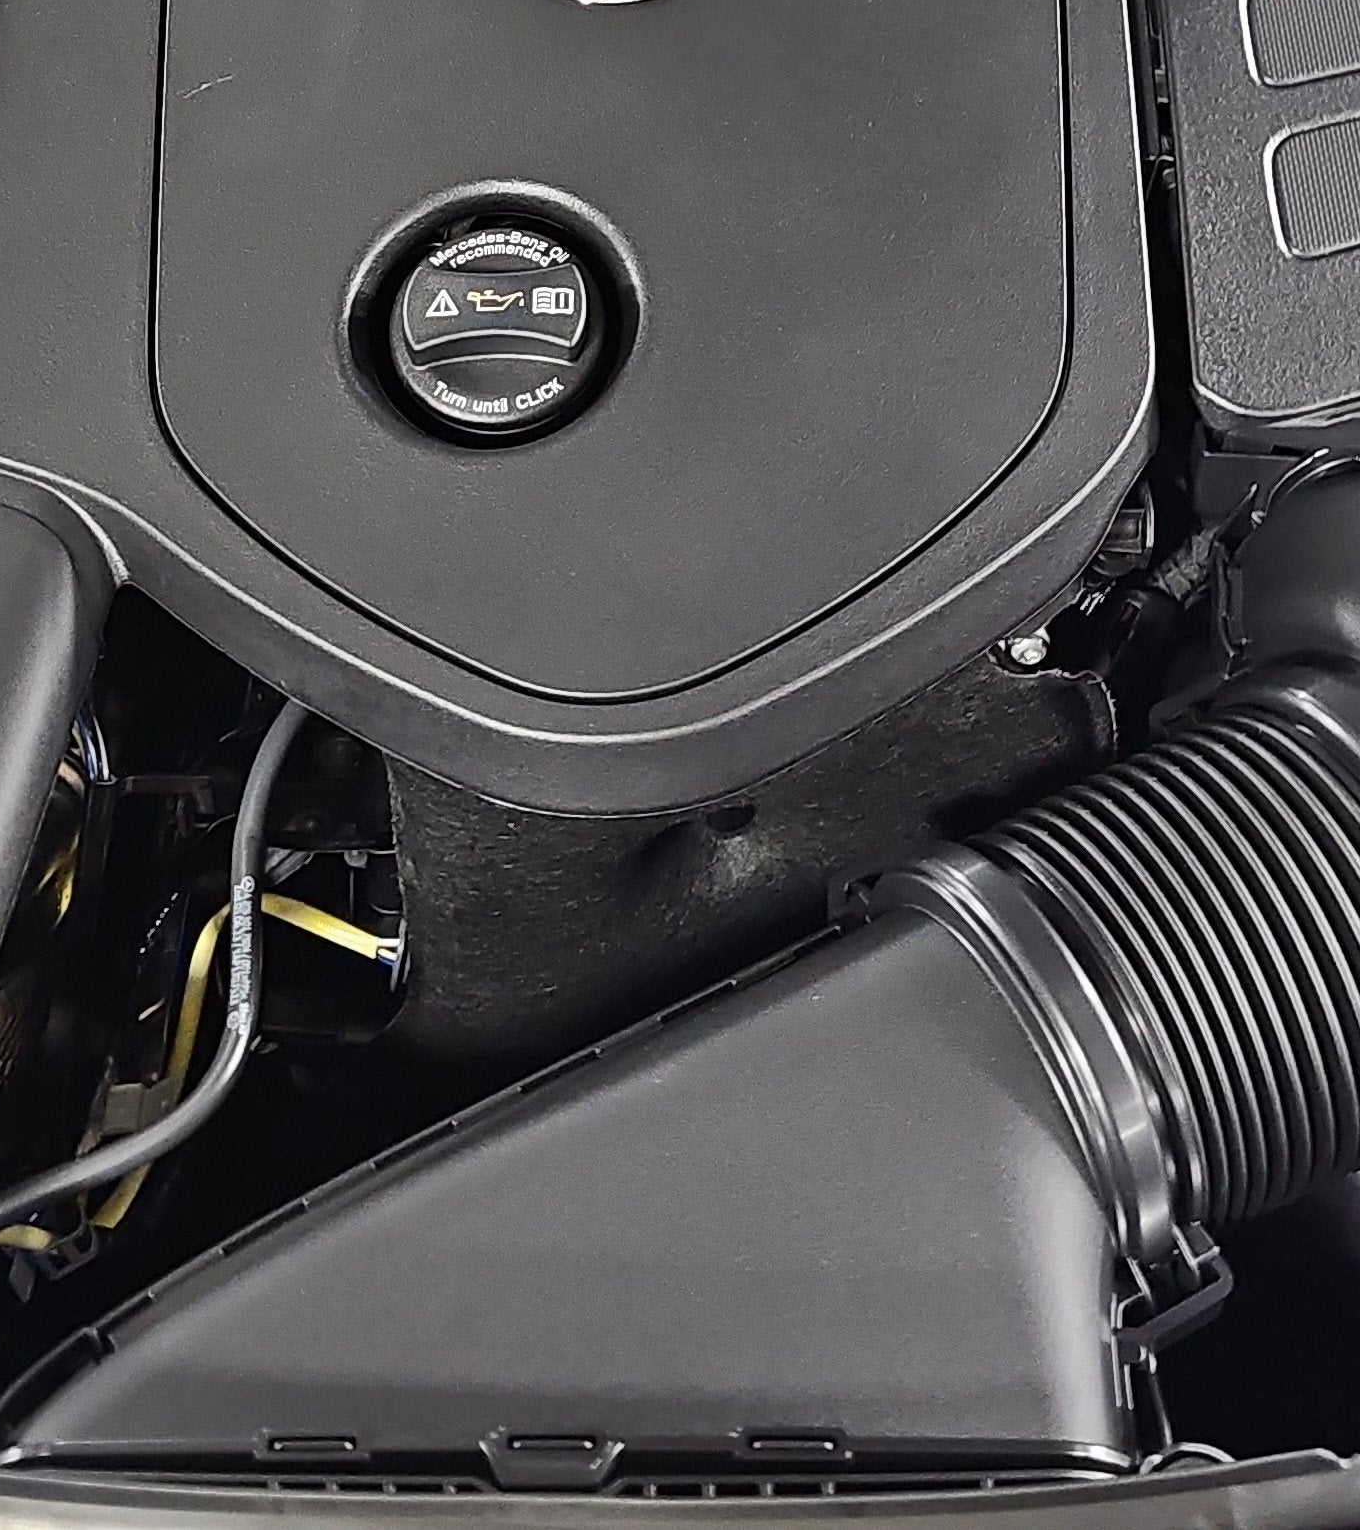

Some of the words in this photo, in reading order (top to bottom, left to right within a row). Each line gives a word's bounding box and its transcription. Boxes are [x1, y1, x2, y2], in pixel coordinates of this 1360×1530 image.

[429, 231, 549, 267] Mercedes-Benz
[549, 244, 571, 264] Oil
[450, 243, 551, 268] recommended
[432, 380, 467, 409] Turn
[472, 396, 508, 413] until
[514, 376, 565, 410] CLICK
